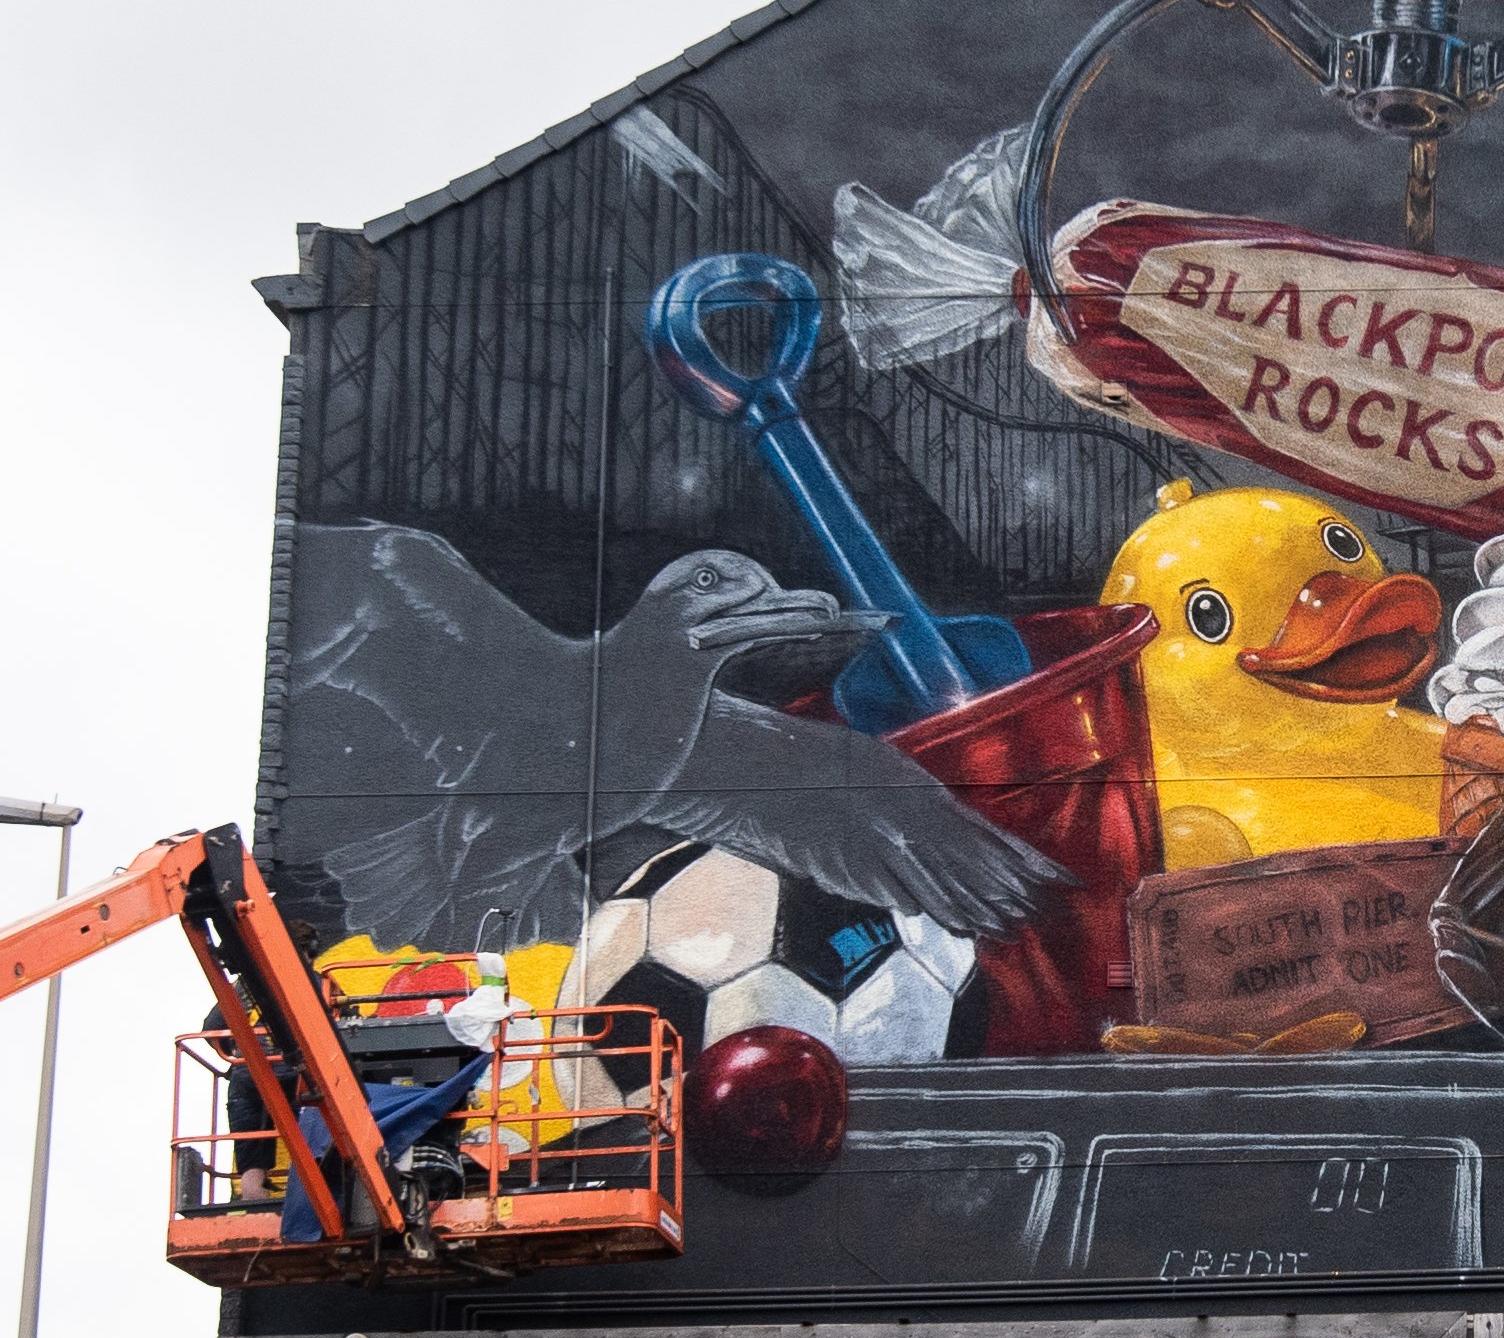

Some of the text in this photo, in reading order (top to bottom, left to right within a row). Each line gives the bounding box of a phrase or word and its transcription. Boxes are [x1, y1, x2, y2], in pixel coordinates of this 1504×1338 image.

[1243, 354, 1504, 481] ROCKS
[1342, 892, 1407, 935] PIER
[1346, 943, 1410, 983] ONE
[1159, 1249, 1309, 1283] CREDIT
